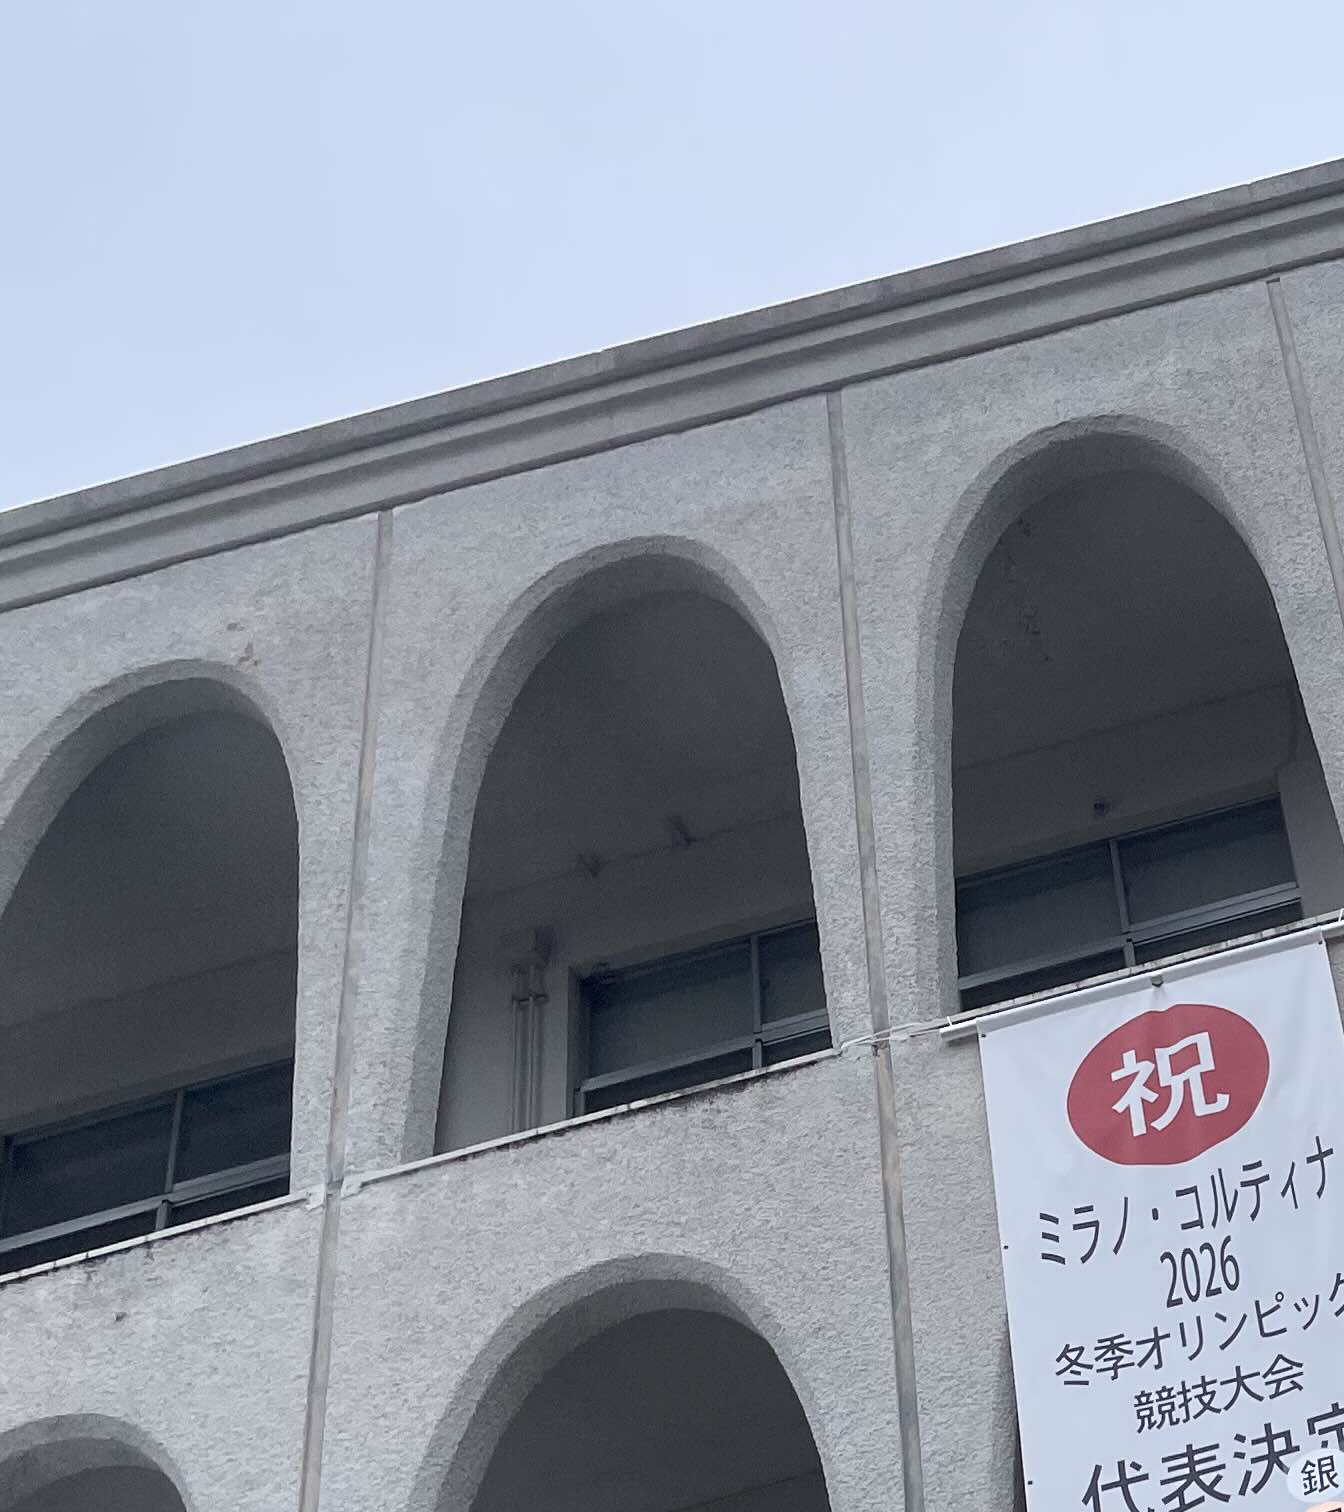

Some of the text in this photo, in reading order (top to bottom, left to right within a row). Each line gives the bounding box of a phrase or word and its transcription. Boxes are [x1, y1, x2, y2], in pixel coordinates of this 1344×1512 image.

[1110, 1031, 1231, 1137] 祝
[1040, 1136, 1334, 1265] ミラノ・コルティナ
[1160, 1235, 1239, 1308] 2026
[1134, 1354, 1304, 1434] 競技大会
[1300, 1455, 1341, 1496] 銀
